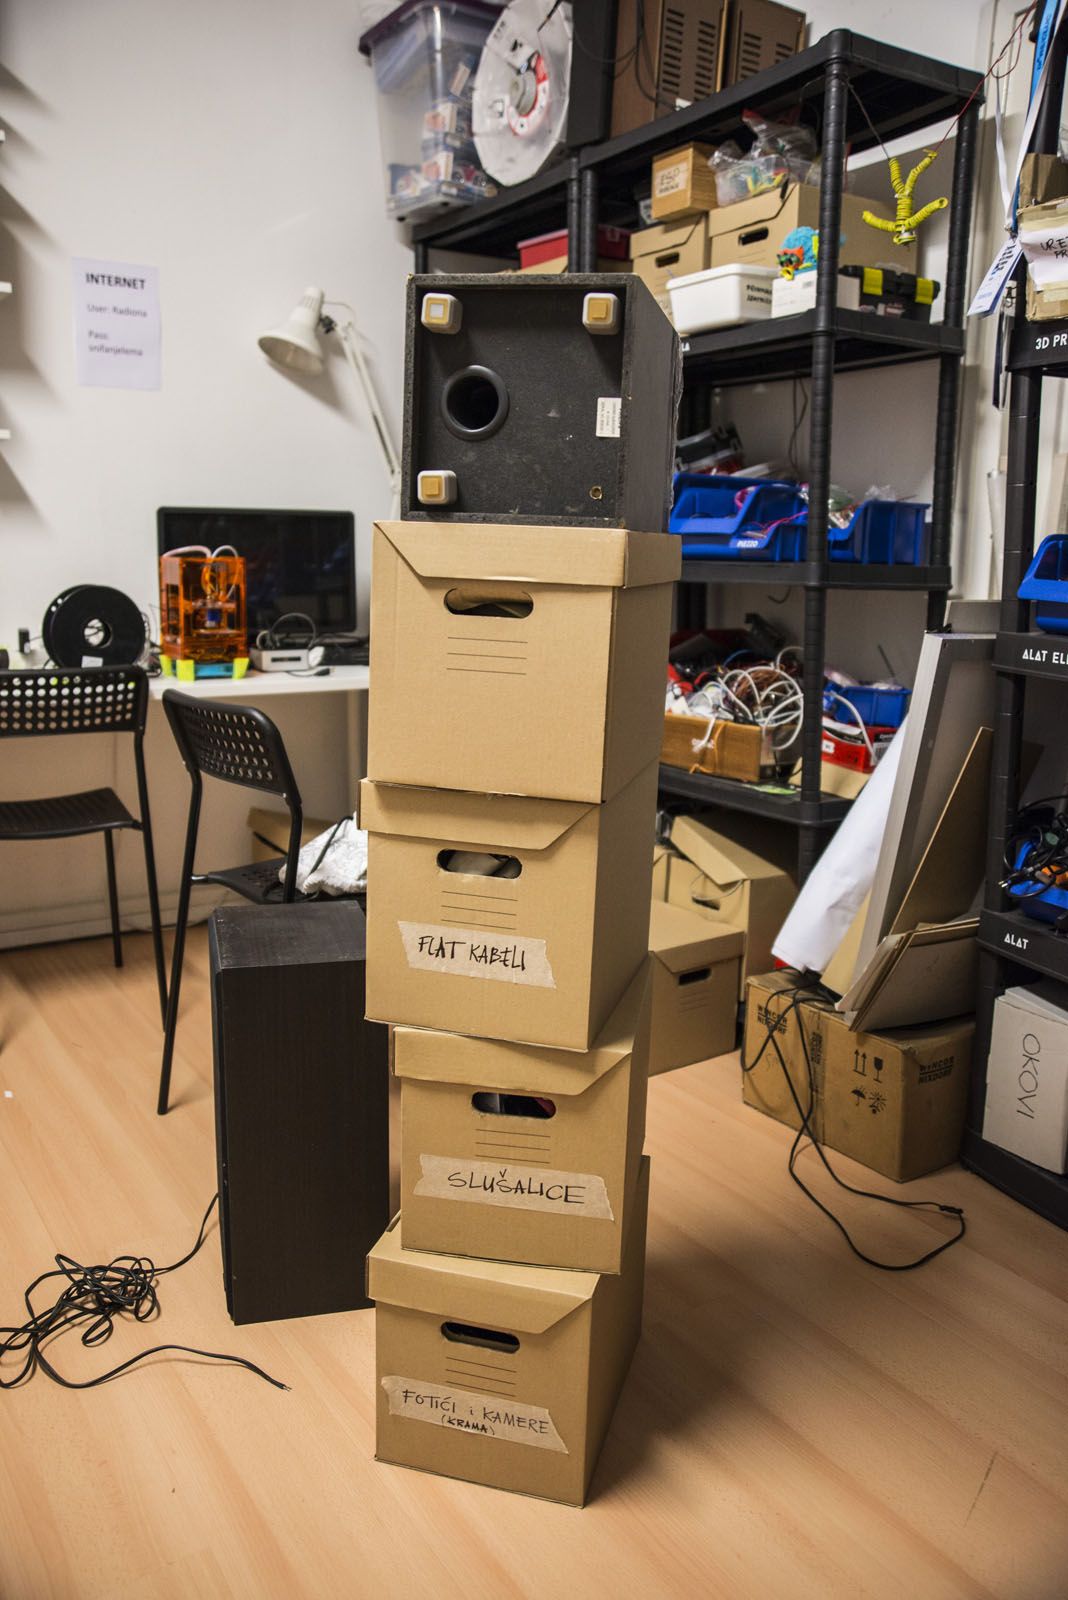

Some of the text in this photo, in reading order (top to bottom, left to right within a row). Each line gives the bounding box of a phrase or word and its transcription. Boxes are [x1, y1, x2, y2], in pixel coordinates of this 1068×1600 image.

[85, 272, 146, 290] INTERNET
[1035, 336, 1050, 350] 3D
[1022, 648, 1048, 662] ALAT
[1004, 933, 1029, 949] ALAT
[418, 935, 526, 971] FLAT KABELI
[1016, 1033, 1040, 1119] OKOVI
[447, 1168, 587, 1204] SLUŠALICE
[402, 1389, 457, 1413] FOTIĆI
[483, 1406, 550, 1434] KAMERE
[441, 1414, 495, 1436] (KRAMA)
